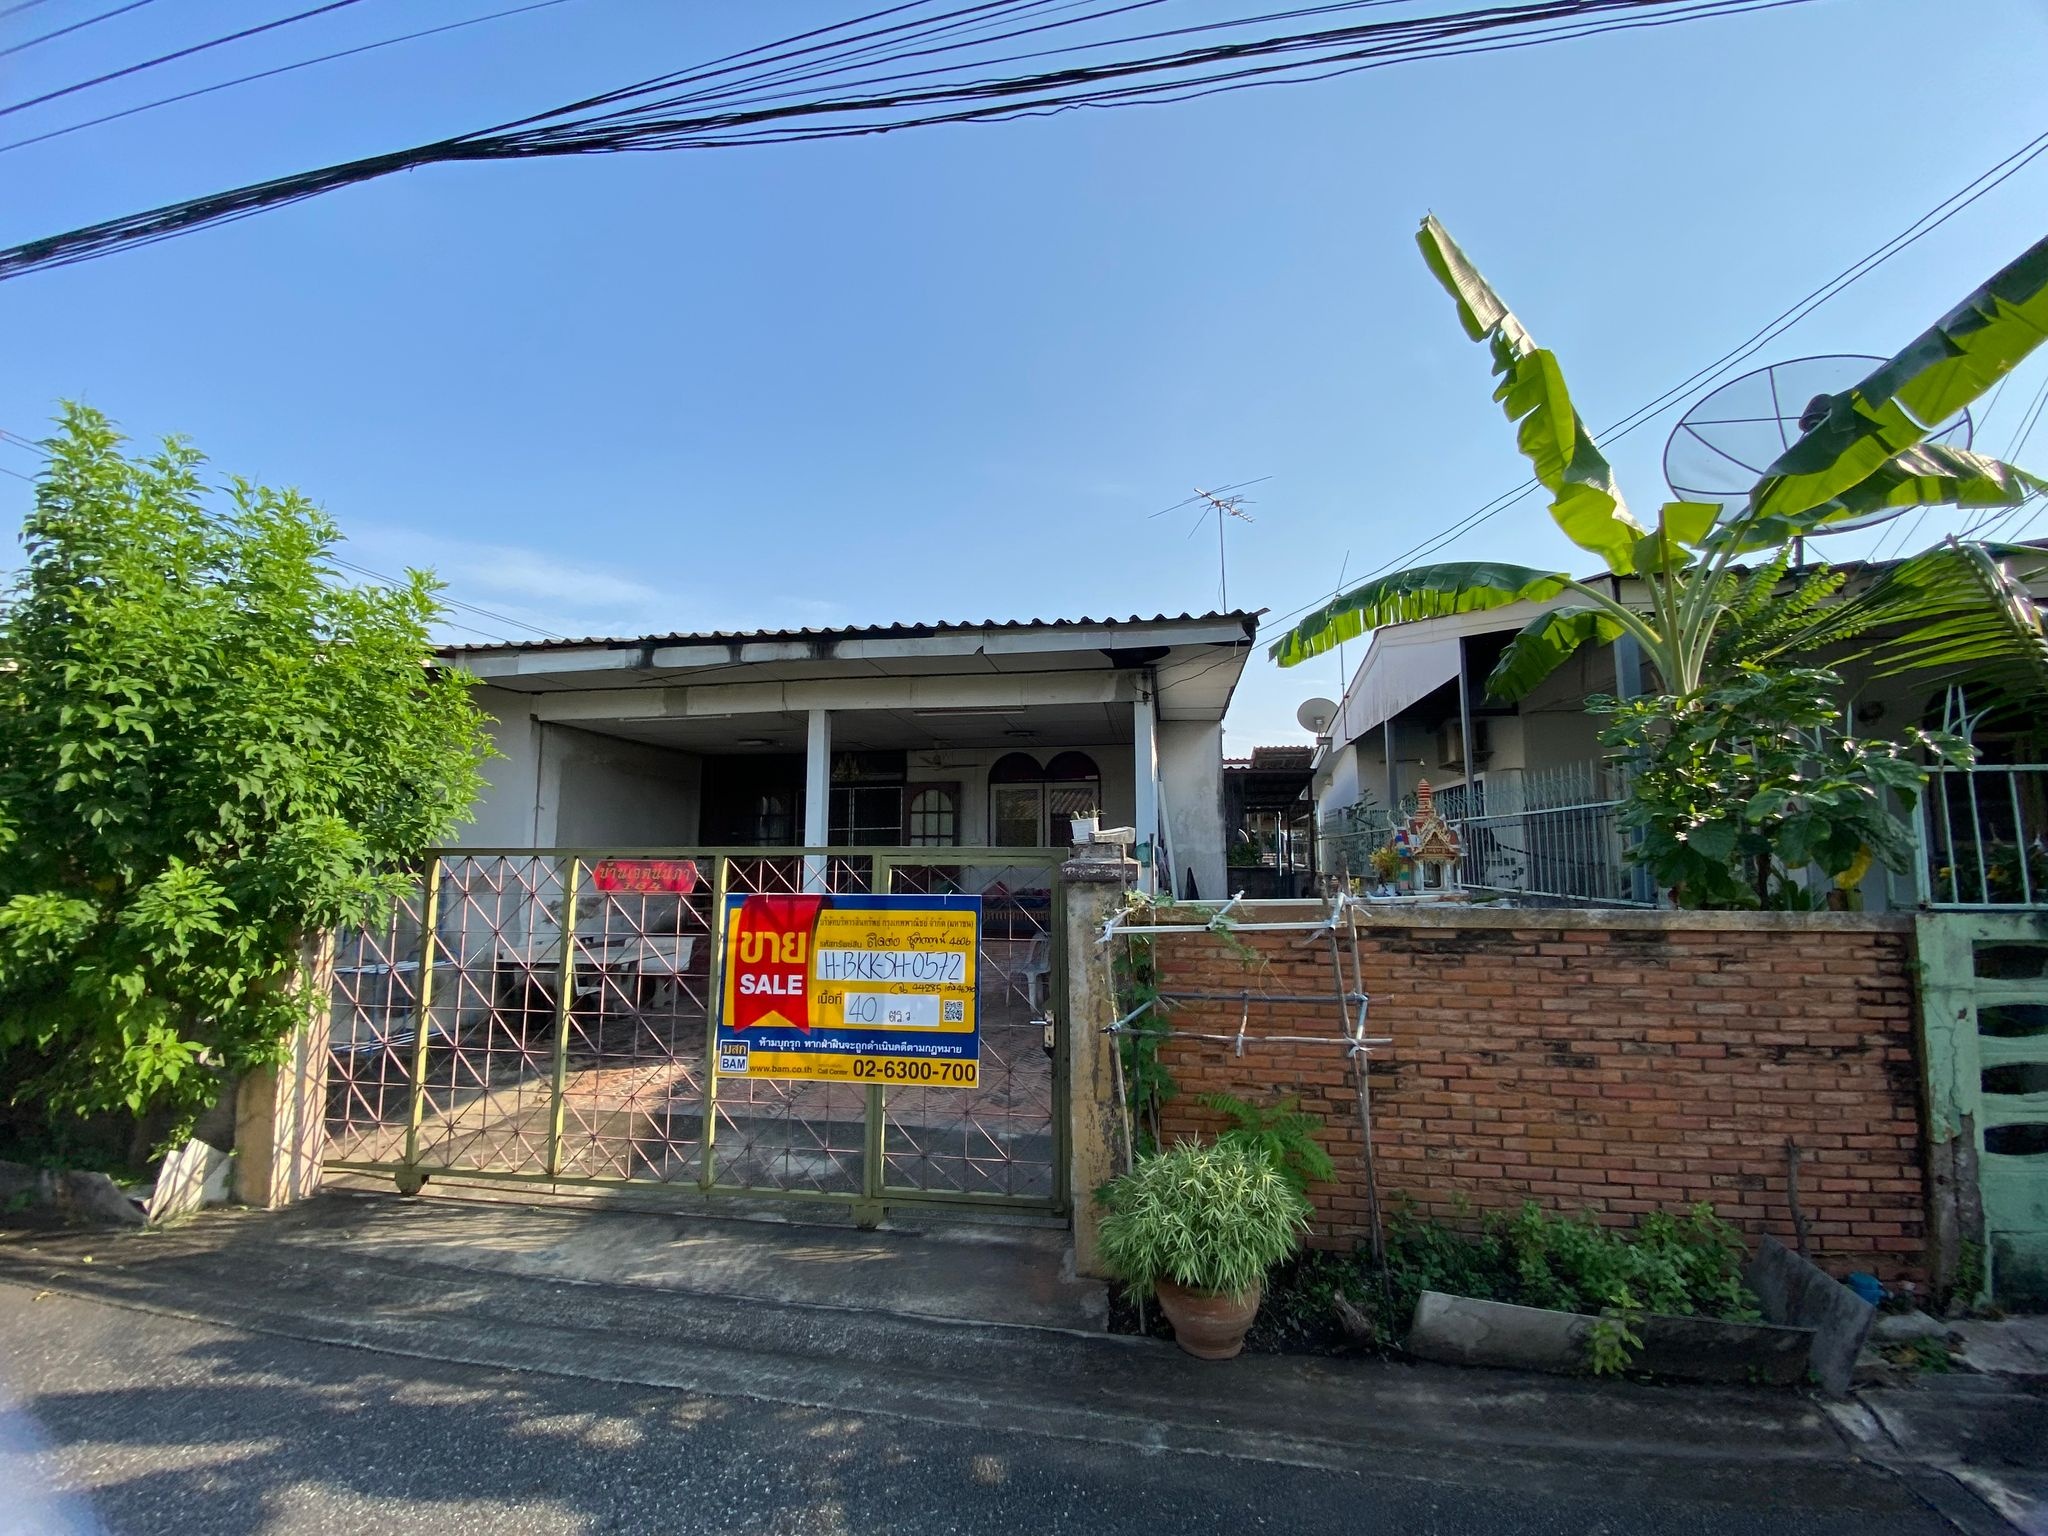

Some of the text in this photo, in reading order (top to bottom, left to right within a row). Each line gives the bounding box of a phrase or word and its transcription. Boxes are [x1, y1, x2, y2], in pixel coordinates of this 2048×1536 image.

[740, 931, 807, 964] ขาย
[739, 973, 803, 995] SALE
[817, 989, 842, 1005] เนื้อที่
[848, 994, 878, 1023] 40
[723, 1043, 747, 1055] บสก
[759, 1037, 801, 1051] ห้ามบุกรุก
[722, 1057, 746, 1069] BAM
[749, 1064, 813, 1074] www.bam.co.th
[853, 1058, 976, 1083] 02-6300-700
